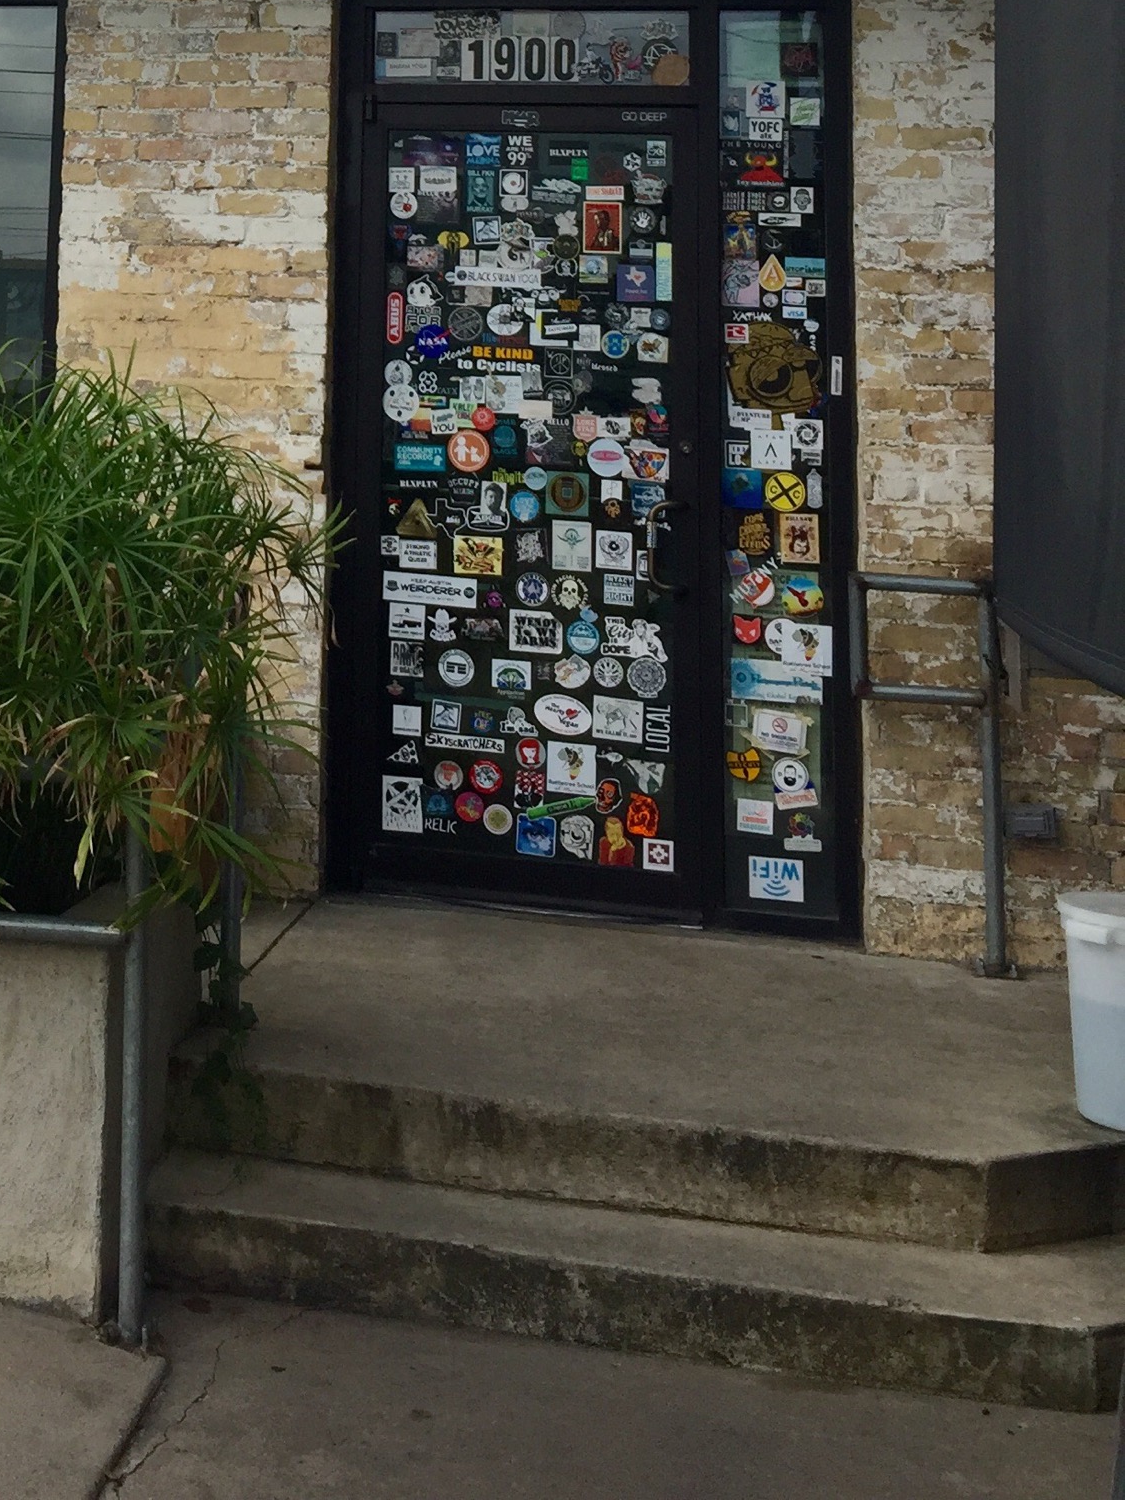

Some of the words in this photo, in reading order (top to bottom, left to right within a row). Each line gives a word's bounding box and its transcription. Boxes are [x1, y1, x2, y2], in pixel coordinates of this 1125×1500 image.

[468, 36, 576, 81] 1900
[621, 111, 637, 122] GO
[639, 111, 667, 122] DEEP
[507, 135, 532, 146] WE
[746, 141, 782, 150] YOUNG
[466, 144, 500, 157] LOVE
[468, 270, 492, 282] BLACK
[492, 272, 516, 283] SWAN
[390, 298, 400, 338] ABUS
[787, 310, 805, 318] VISA
[418, 337, 449, 346] NASA
[472, 345, 492, 359] BE
[494, 346, 535, 361] KIND
[457, 357, 472, 369] to
[477, 359, 542, 373] Cyclists
[546, 418, 570, 426] HELLO
[433, 423, 456, 433] YOU
[396, 445, 443, 455] COMMUNITY
[396, 452, 435, 461] RECORDS
[447, 477, 480, 489] OCCUPY
[769, 485, 778, 495] C
[792, 490, 801, 500] C
[400, 584, 462, 597] WEIRDERER
[606, 617, 624, 625] THIS
[608, 624, 635, 643] City
[602, 644, 631, 655] DOPE
[502, 721, 515, 732] I'm
[645, 704, 671, 753] LOCAL
[426, 733, 504, 752] SKYSCRATCHERS
[424, 817, 458, 835] RELIC
[751, 858, 801, 881] WiFi
